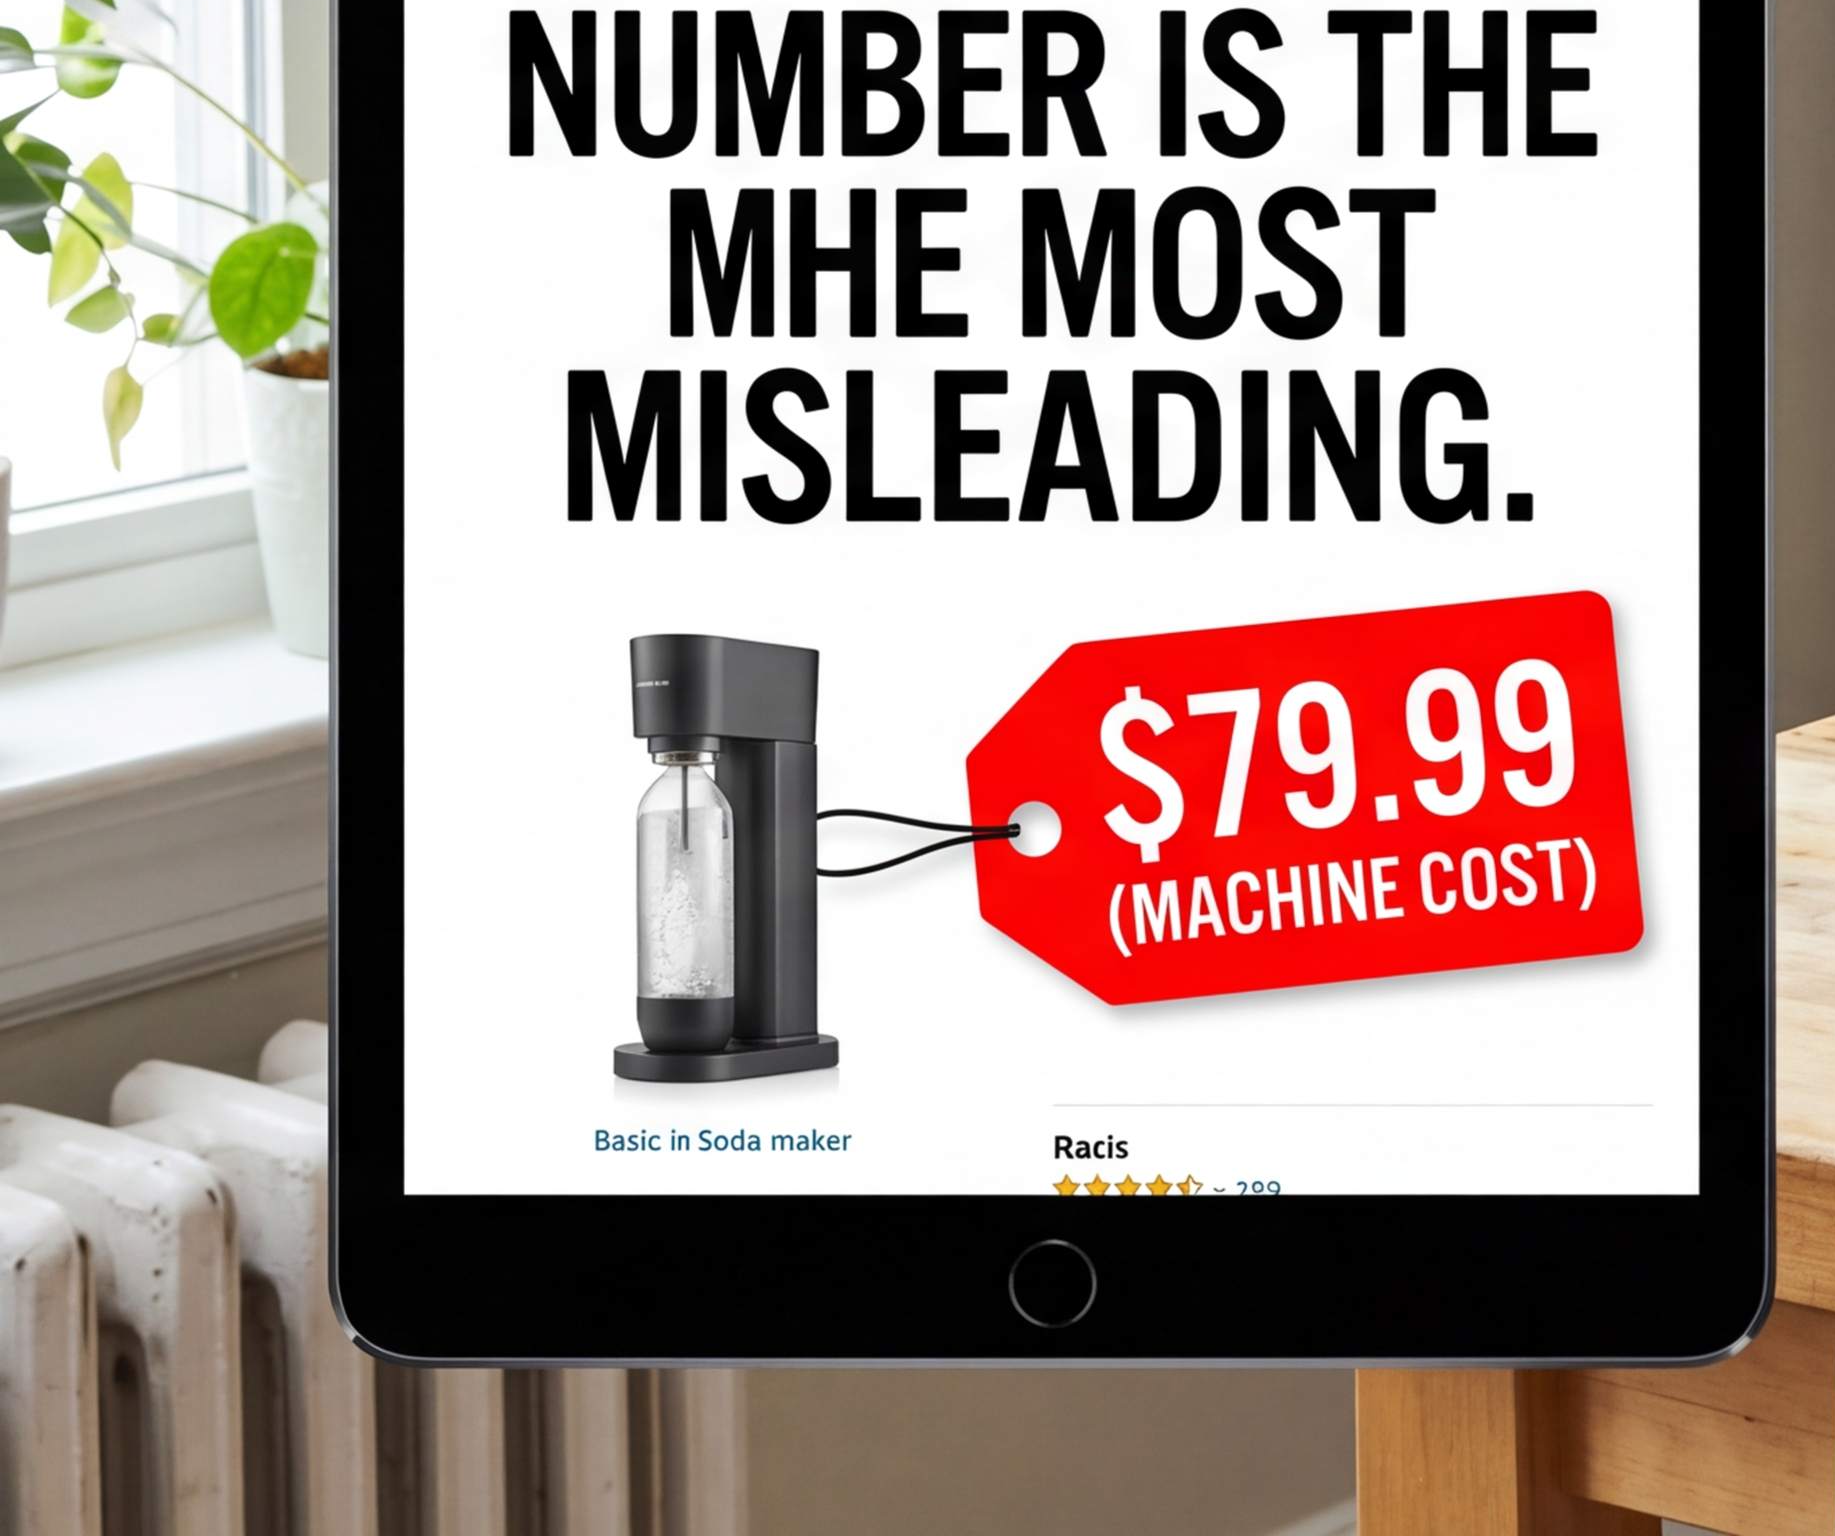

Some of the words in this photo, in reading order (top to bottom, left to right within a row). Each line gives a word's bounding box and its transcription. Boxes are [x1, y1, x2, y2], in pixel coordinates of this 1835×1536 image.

[508, 9, 1107, 158] NUMBER
[1160, 7, 1286, 159] IS
[1328, 9, 1599, 158] THE
[668, 187, 970, 338] MHE
[1021, 185, 1436, 340] MOST
[567, 367, 1534, 524] MISLEADING.
[1100, 658, 1576, 864] $79.99
[1107, 855, 1405, 959] (MACHINE
[1419, 836, 1598, 916] COST)
[594, 1127, 664, 1154] Basic
[669, 1128, 691, 1154] in
[697, 1127, 762, 1154] Soda
[769, 1128, 853, 1154] maker
[1054, 1134, 1129, 1160] Racis
